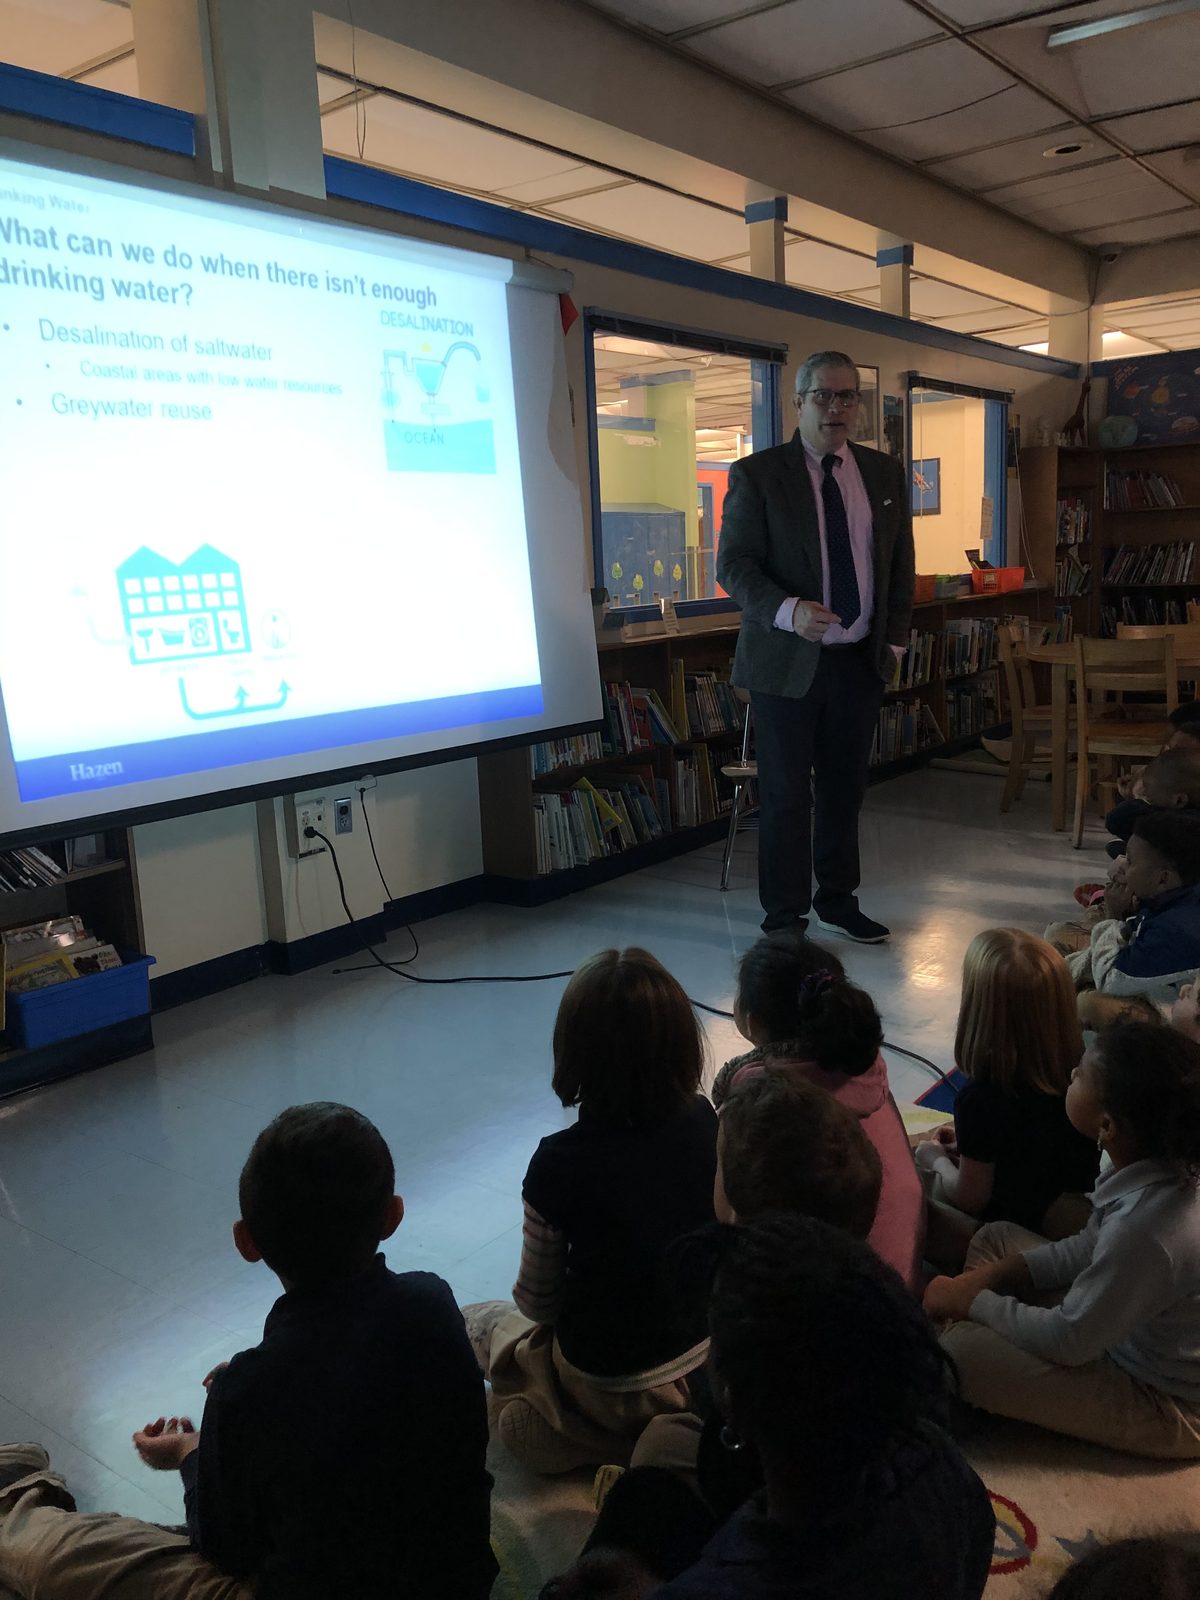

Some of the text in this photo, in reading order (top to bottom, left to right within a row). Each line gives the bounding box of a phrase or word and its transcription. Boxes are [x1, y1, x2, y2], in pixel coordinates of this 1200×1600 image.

[48, 194, 89, 213] Water
[0, 257, 193, 306] drinking water?
[67, 233, 112, 258] can
[121, 241, 155, 264] we
[163, 245, 193, 270] do
[200, 253, 260, 281] when
[266, 262, 319, 289] there
[325, 270, 366, 297] isn't
[371, 281, 437, 310] enough
[380, 310, 475, 337] DESALINATION
[38, 318, 273, 361] Desalination of saltwater
[80, 360, 343, 396] Coastal areas with low water resources
[51, 393, 213, 421] Greywater reuse
[404, 431, 444, 445] OCEAN
[69, 760, 124, 782] Hazen
